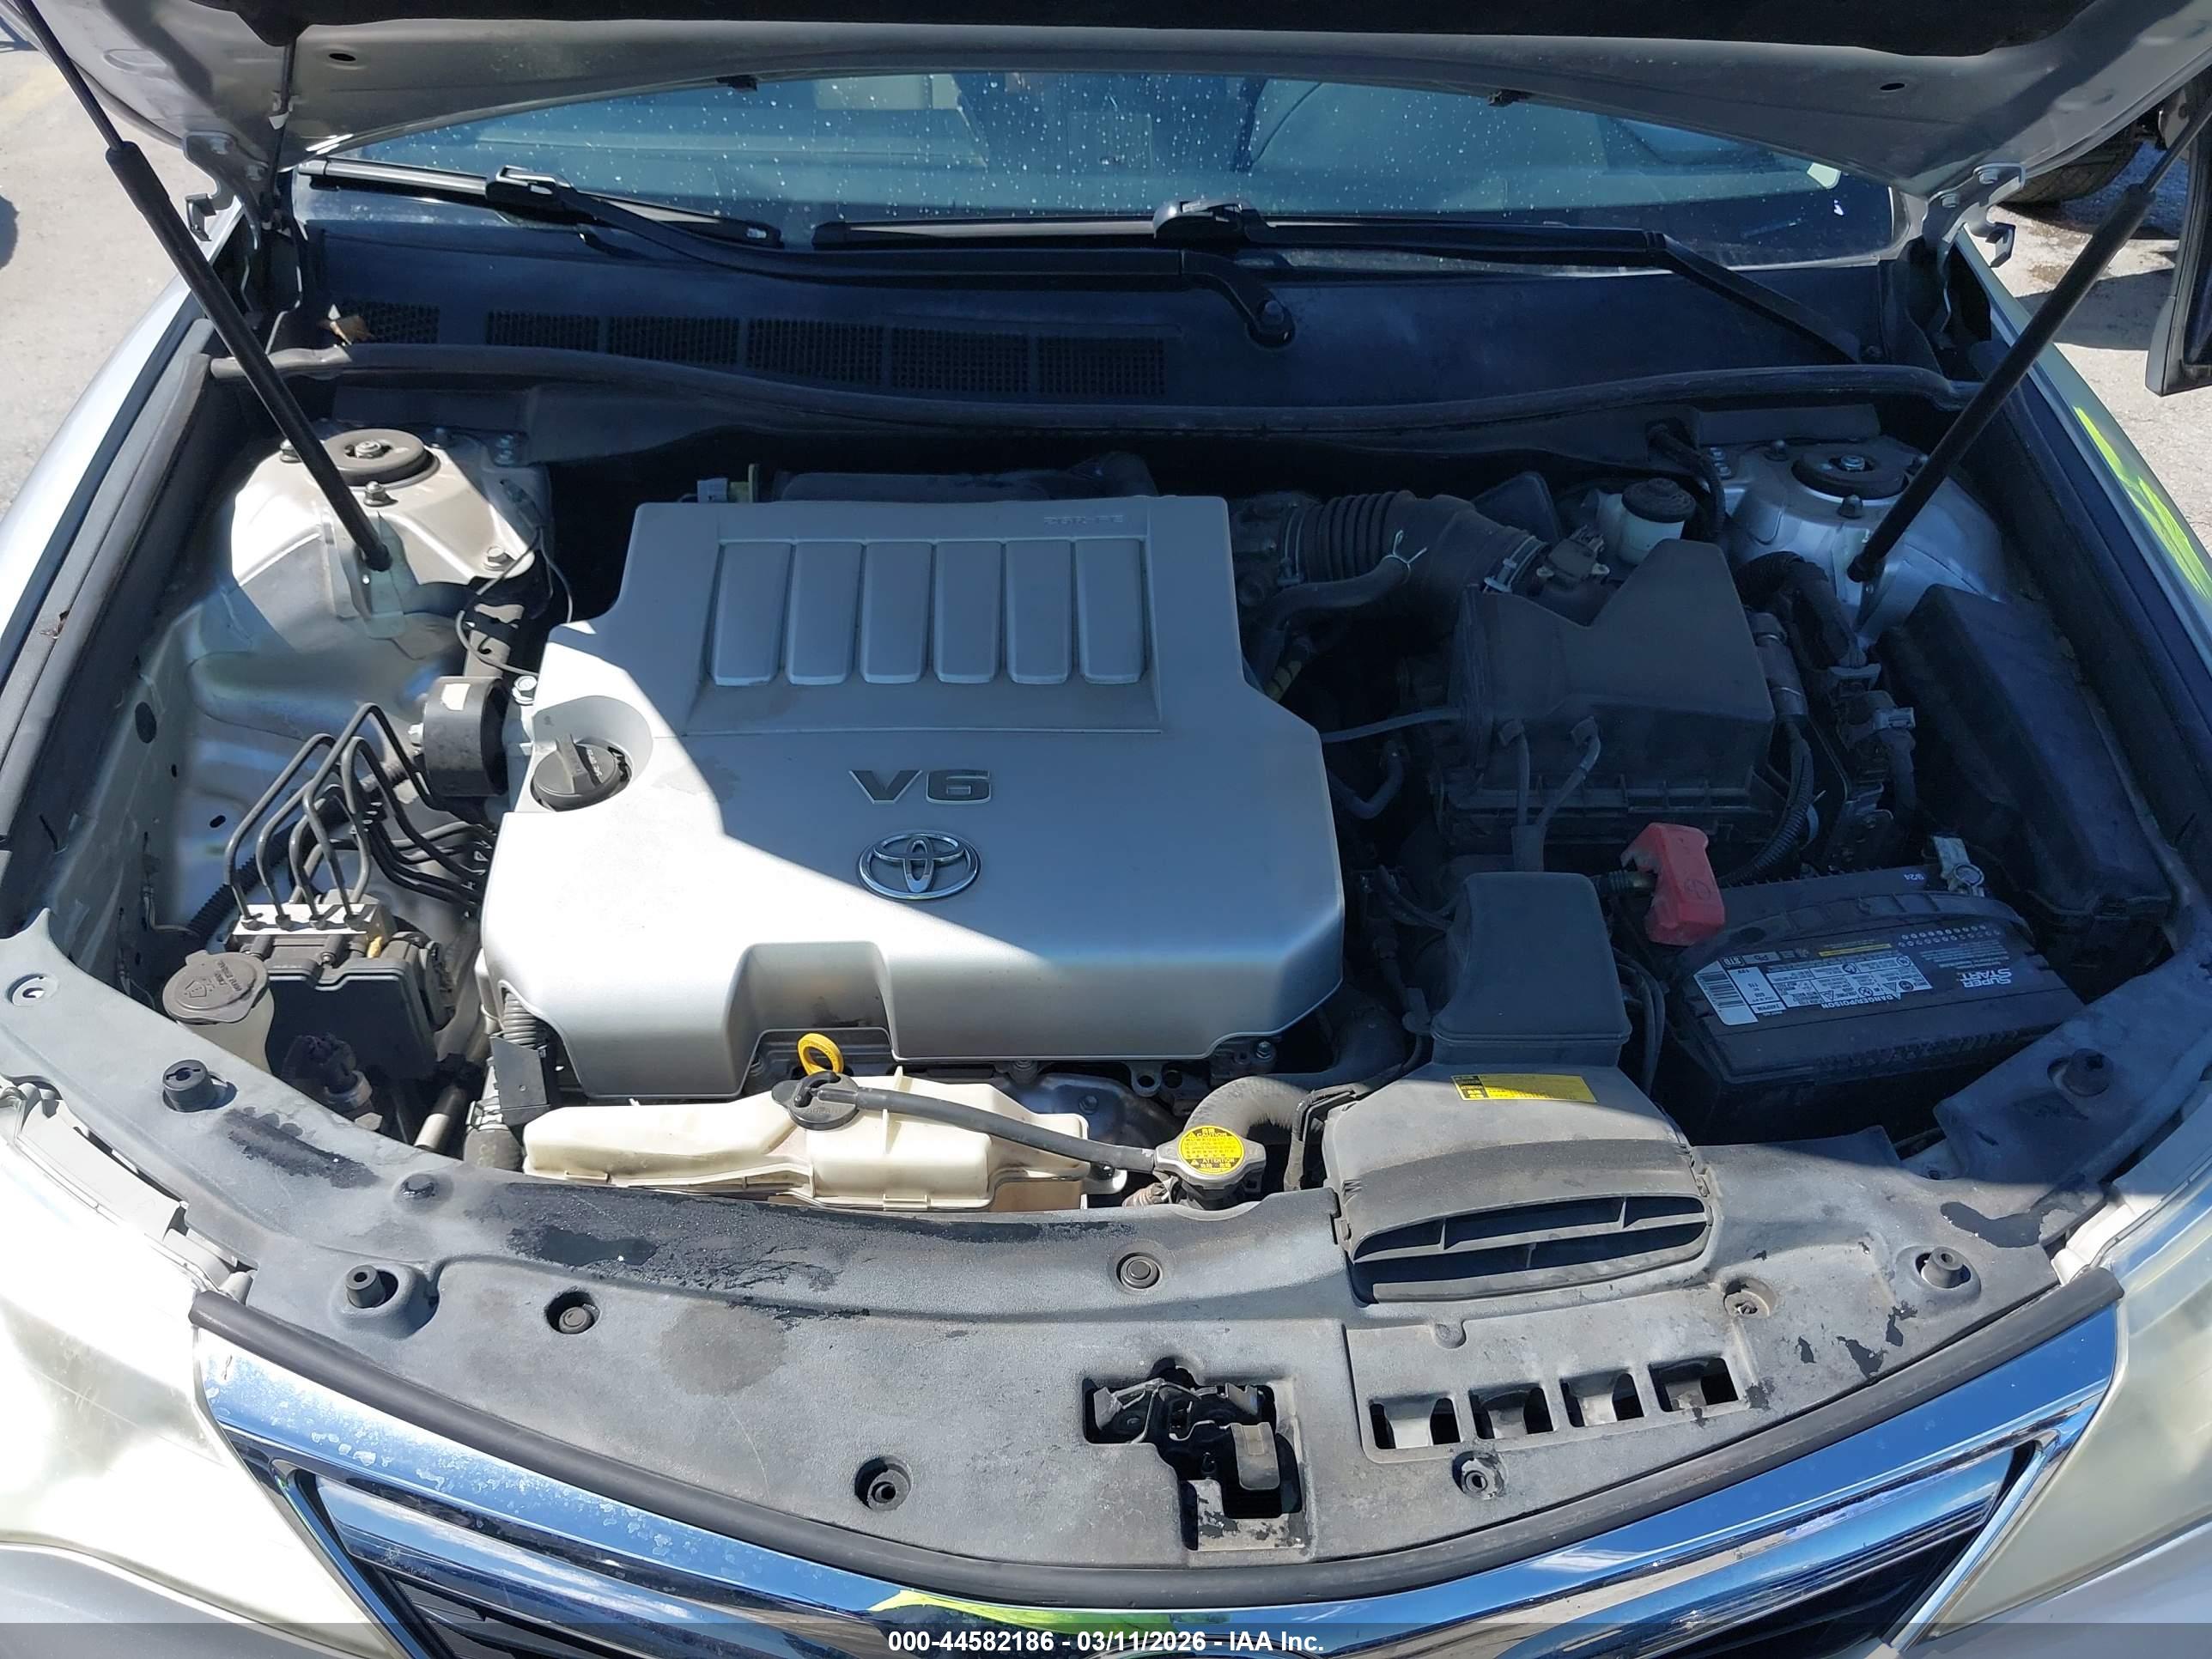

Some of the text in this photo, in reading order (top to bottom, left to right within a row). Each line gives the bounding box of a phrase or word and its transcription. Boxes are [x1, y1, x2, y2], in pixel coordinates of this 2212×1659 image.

[848, 769, 991, 805] V6
[1959, 968, 2013, 982] START
[1962, 975, 2012, 988] SUPER
[1820, 994, 1894, 1009] DANGER/POISON
